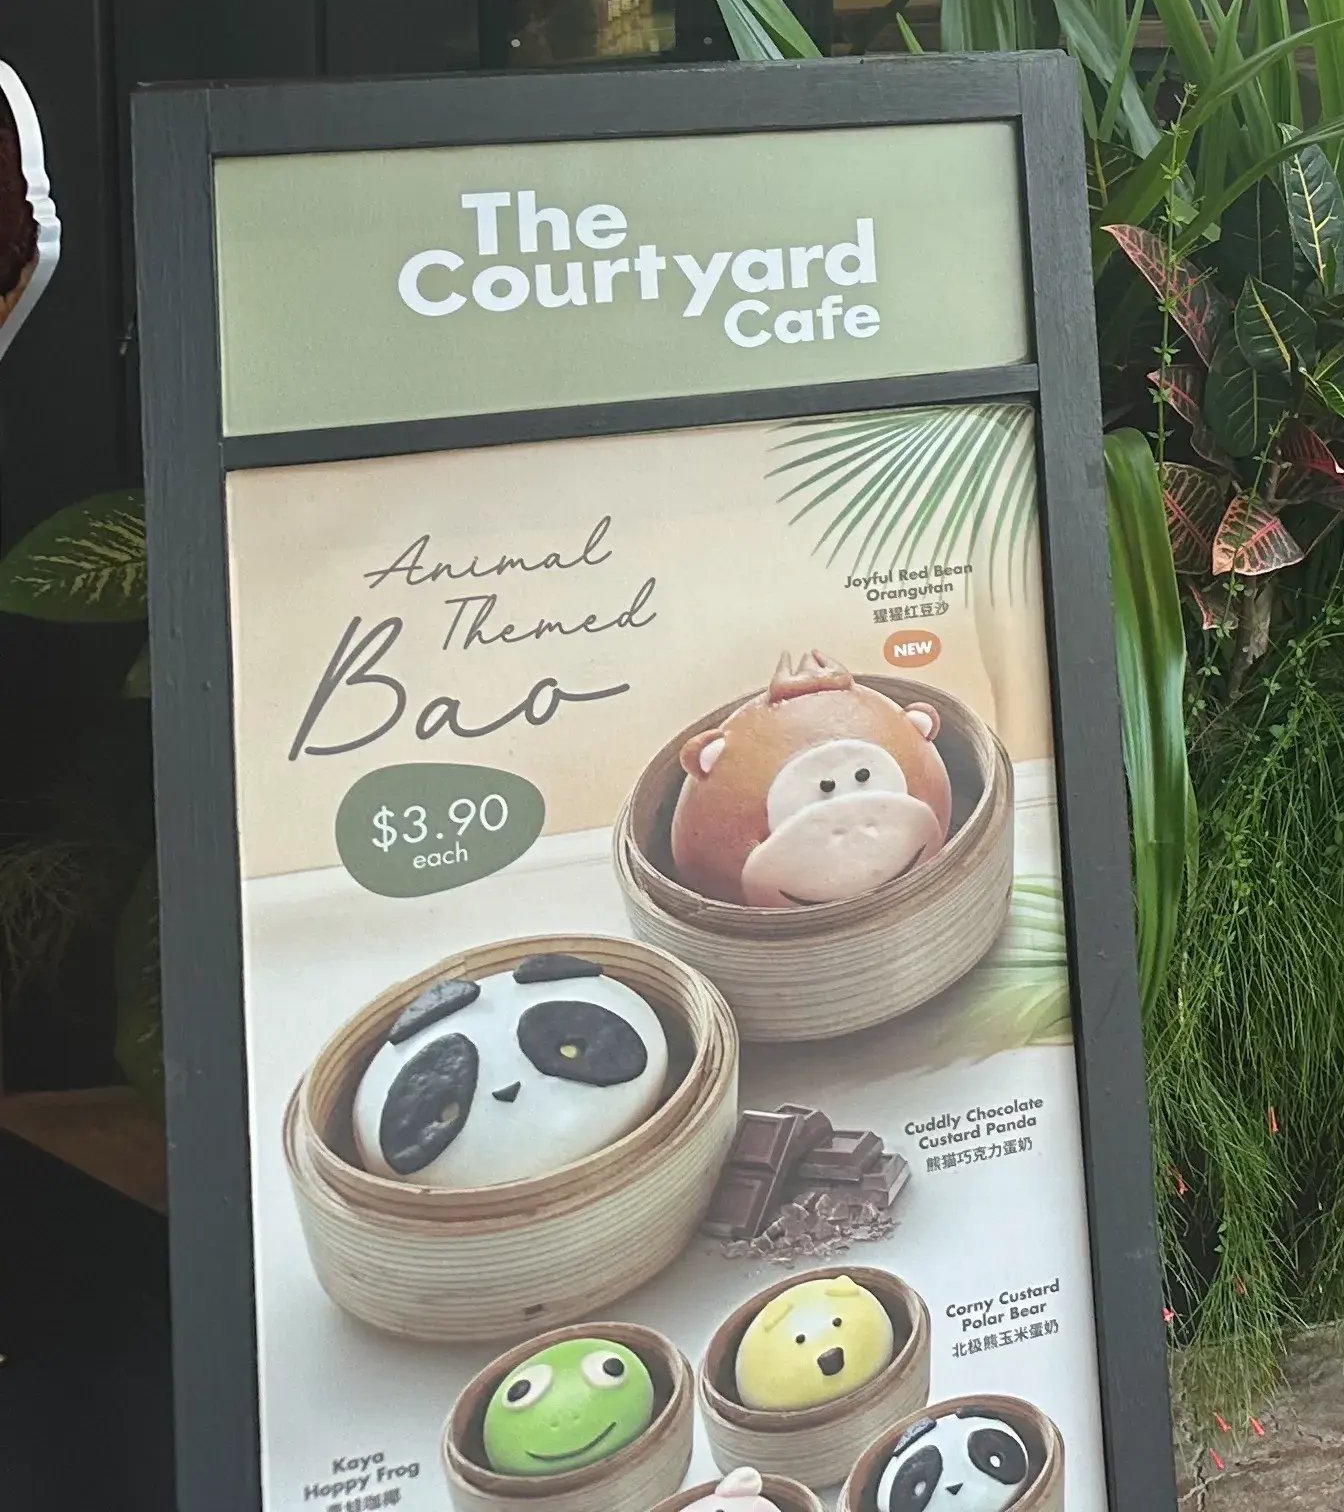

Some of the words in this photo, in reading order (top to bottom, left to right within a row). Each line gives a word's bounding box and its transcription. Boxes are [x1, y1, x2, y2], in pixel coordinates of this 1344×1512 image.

[460, 190, 628, 256] The
[397, 218, 878, 318] Courtyard
[723, 295, 882, 348] Cafe
[363, 515, 614, 589] Animal
[844, 569, 893, 590] Joyful
[899, 566, 929, 582] Red
[934, 564, 973, 578] Bean
[866, 582, 954, 602] Orangutan
[440, 577, 659, 653] Themed
[872, 600, 950, 624] 猩猩红豆沙
[893, 640, 933, 658] NEW
[288, 615, 632, 763] Bao
[370, 793, 510, 853] $3.90
[412, 841, 470, 870] each
[904, 1113, 961, 1136] Cuddly
[966, 1098, 1044, 1123] Chocolate
[918, 1124, 981, 1149] Custard
[986, 1114, 1037, 1136] Panda
[926, 1136, 1033, 1172] 熊猫巧克力蛋奶
[946, 1298, 994, 1318] Corny
[998, 1278, 1060, 1305] Custard
[962, 1313, 1005, 1332] Polar
[1009, 1302, 1047, 1320] Bear
[951, 1319, 1059, 1358] 北极熊玉米蛋奶
[331, 1452, 385, 1475] Kaya
[376, 1462, 420, 1482] Frog
